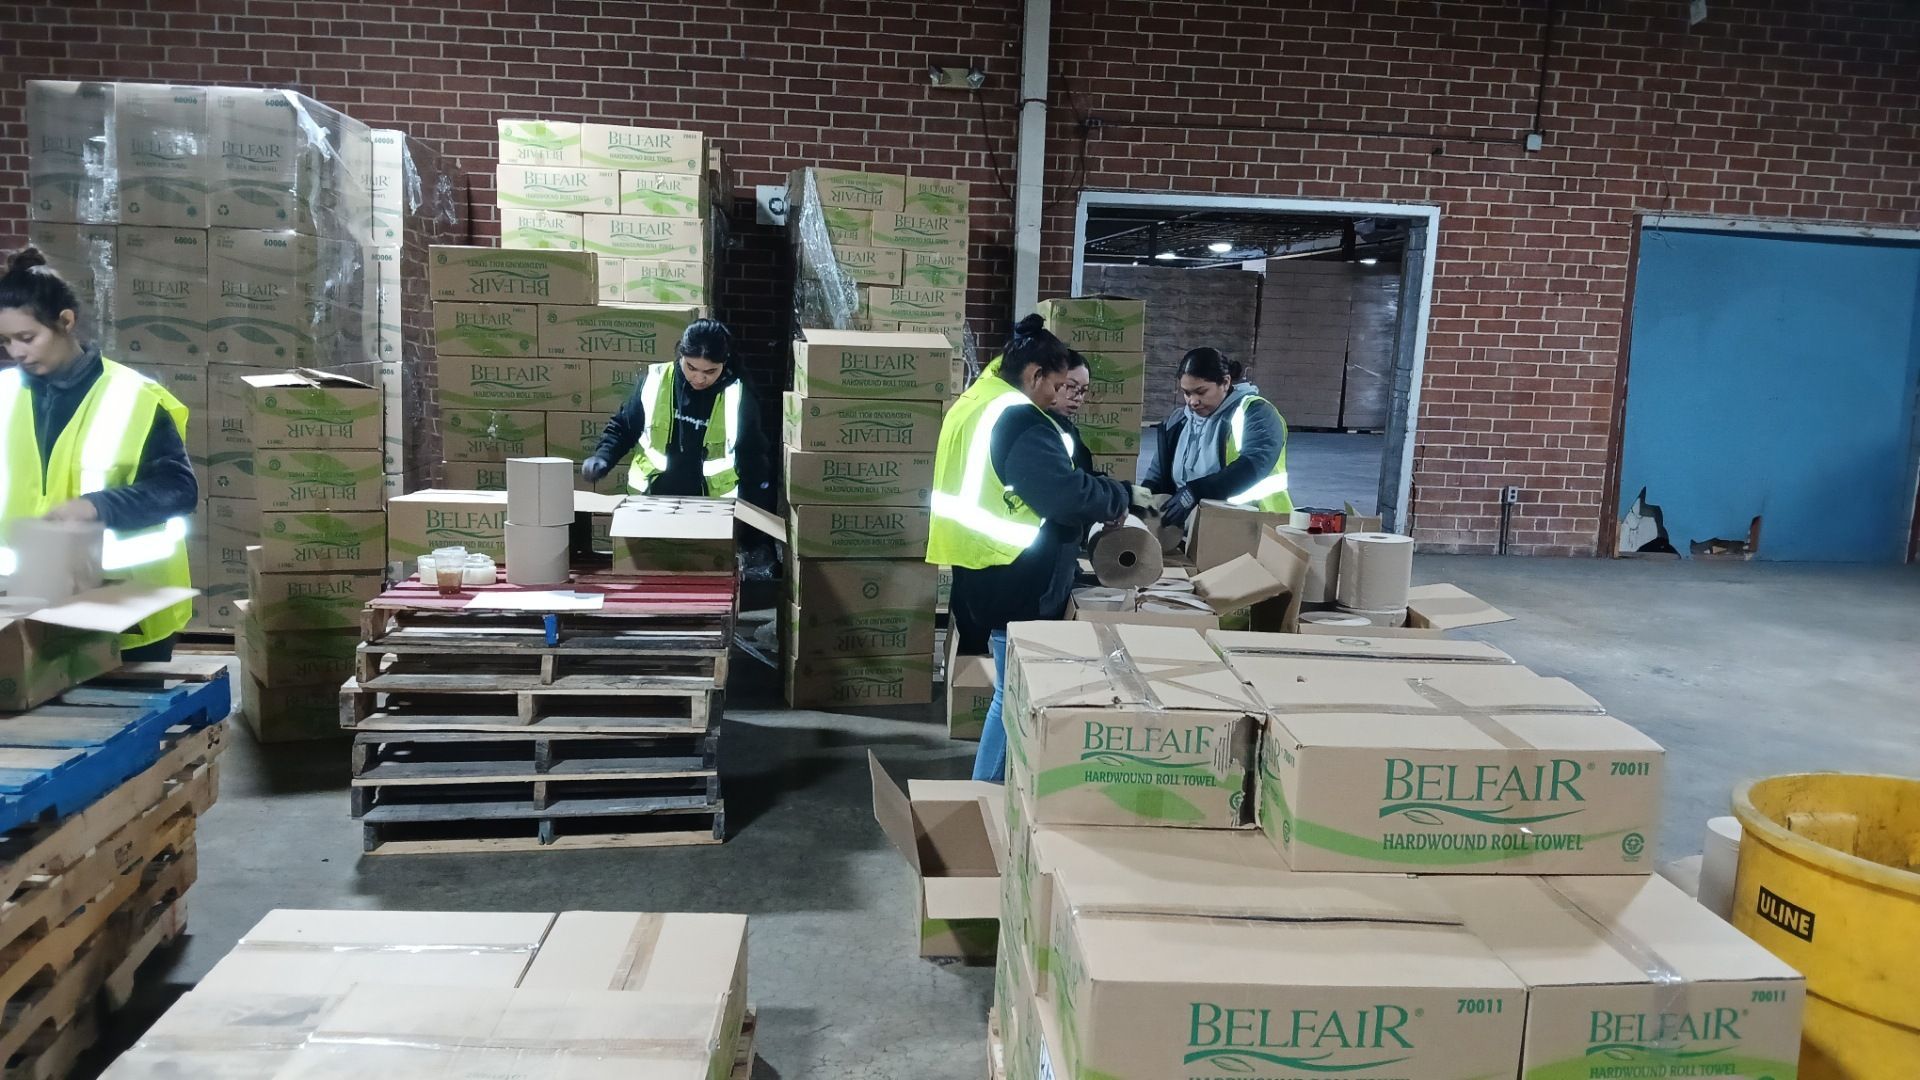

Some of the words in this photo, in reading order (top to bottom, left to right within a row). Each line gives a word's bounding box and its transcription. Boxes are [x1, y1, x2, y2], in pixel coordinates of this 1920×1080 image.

[608, 131, 672, 149] BELFAIR
[222, 141, 281, 158] BELFAIR
[518, 148, 563, 161] BELFAIR
[524, 171, 588, 187] BELFAIR
[831, 190, 883, 206] BELFAIR
[518, 216, 565, 229] BELFAIR
[610, 220, 673, 236] BELFAIR
[894, 214, 950, 231] BELFAIR
[264, 238, 287, 248] 60006
[840, 252, 876, 264] LFAIR
[916, 254, 954, 266] BELFAIR
[641, 266, 686, 279] BELFAIR
[132, 279, 190, 295] BELFAIR
[221, 280, 280, 297] BELFAIR
[469, 277, 550, 297] BELFAIR
[891, 287, 945, 304] BELFAIR
[456, 311, 513, 326] BELFAIR
[1072, 330, 1124, 342] BELFAIR
[577, 336, 656, 355] BELFAIR
[840, 352, 917, 370] BELFAIR
[471, 364, 552, 382] BELFAIR
[287, 424, 353, 439] BELFAIR
[839, 428, 913, 445] BELFAIR
[468, 440, 524, 454] BELFAIR
[823, 459, 900, 477] BELFAIR
[290, 487, 356, 501] BELFAIR
[830, 513, 905, 530] BELFAIR
[295, 547, 360, 562] BELFAIR
[288, 580, 354, 596] BELFAIR
[836, 633, 907, 650] BELFAIR
[834, 683, 904, 699] BELFAIR
[1085, 770, 1153, 784] HARDWOUND
[1155, 772, 1180, 785] ROLL
[1182, 773, 1217, 788] TOWEL
[1382, 758, 1586, 802] BELFAIR
[1610, 761, 1650, 776] 70011
[1383, 833, 1487, 851] HARDWOUND
[1491, 833, 1531, 851] ROLL
[1533, 833, 1584, 851] TOWEL
[1760, 892, 1811, 936] ULINE
[1187, 1002, 1415, 1049] BELFAIR
[1457, 999, 1503, 1014] 70011
[1588, 1007, 1742, 1043] BELFAIR
[1751, 990, 1787, 1003] 70011
[1590, 1064, 1666, 1079] HARDWOUND
[1669, 1063, 1698, 1077] ROLL
[1698, 1062, 1737, 1076] TOWEL
